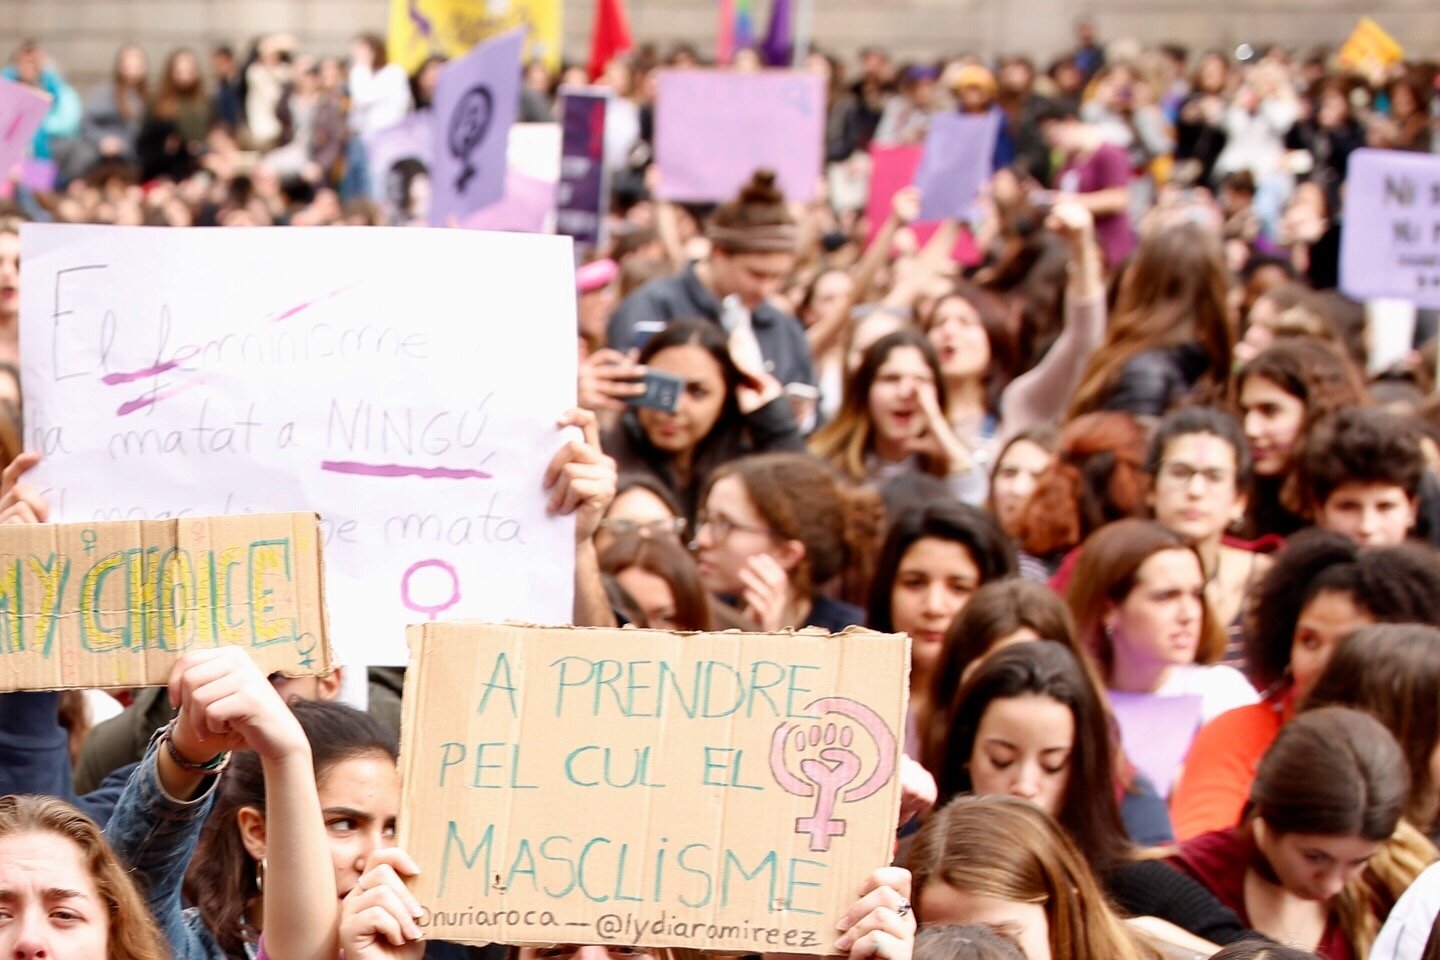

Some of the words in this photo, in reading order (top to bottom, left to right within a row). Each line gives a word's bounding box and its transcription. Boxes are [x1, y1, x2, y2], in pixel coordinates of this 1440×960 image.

[53, 263, 117, 382] El
[109, 402, 263, 460] matat
[277, 423, 301, 449] a
[382, 491, 528, 547] mata
[80, 537, 300, 655] CHOICE
[477, 652, 518, 718] A
[550, 656, 822, 720] PRENDRE
[438, 742, 540, 789] PEL
[564, 744, 668, 789] CUL
[702, 746, 765, 791] EL
